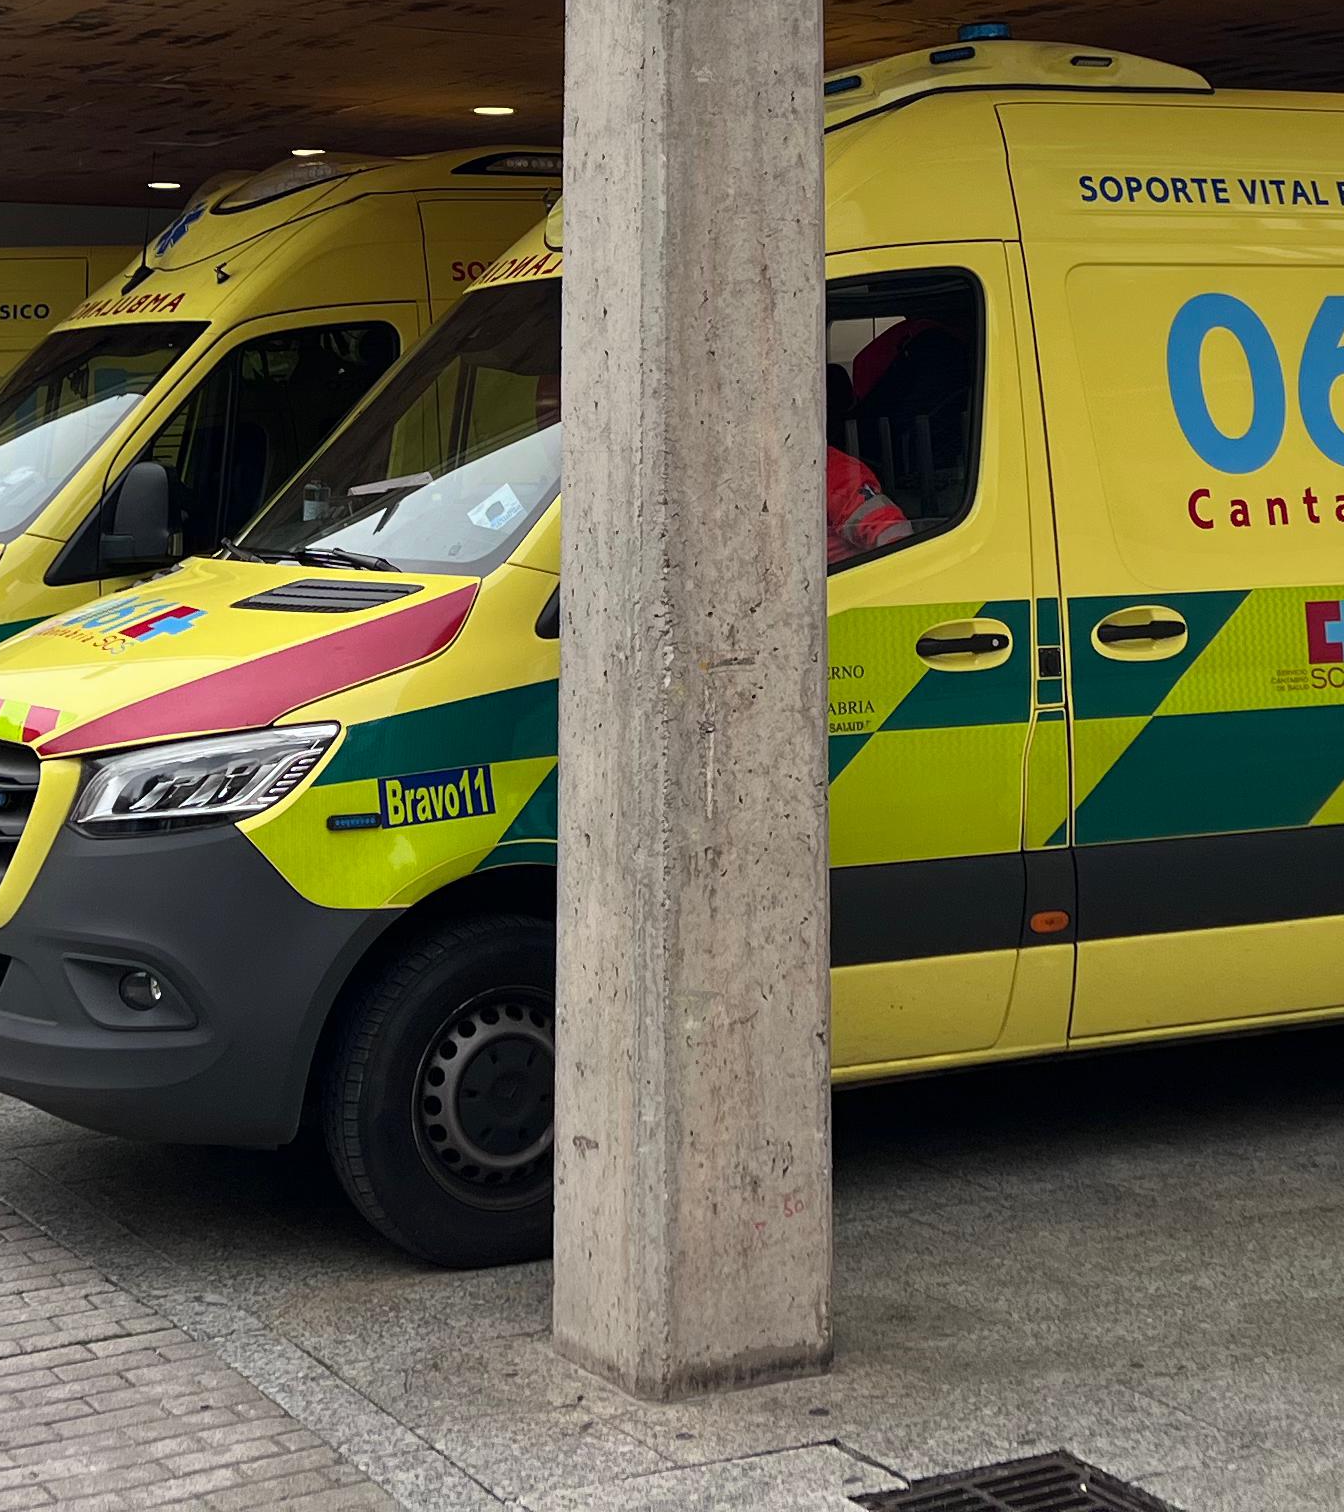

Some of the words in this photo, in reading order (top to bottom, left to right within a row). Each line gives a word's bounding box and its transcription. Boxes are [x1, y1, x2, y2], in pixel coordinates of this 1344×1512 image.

[1079, 176, 1230, 204] SOPORTE
[1241, 178, 1328, 206] VITAL
[385, 767, 489, 826] Bravo11
